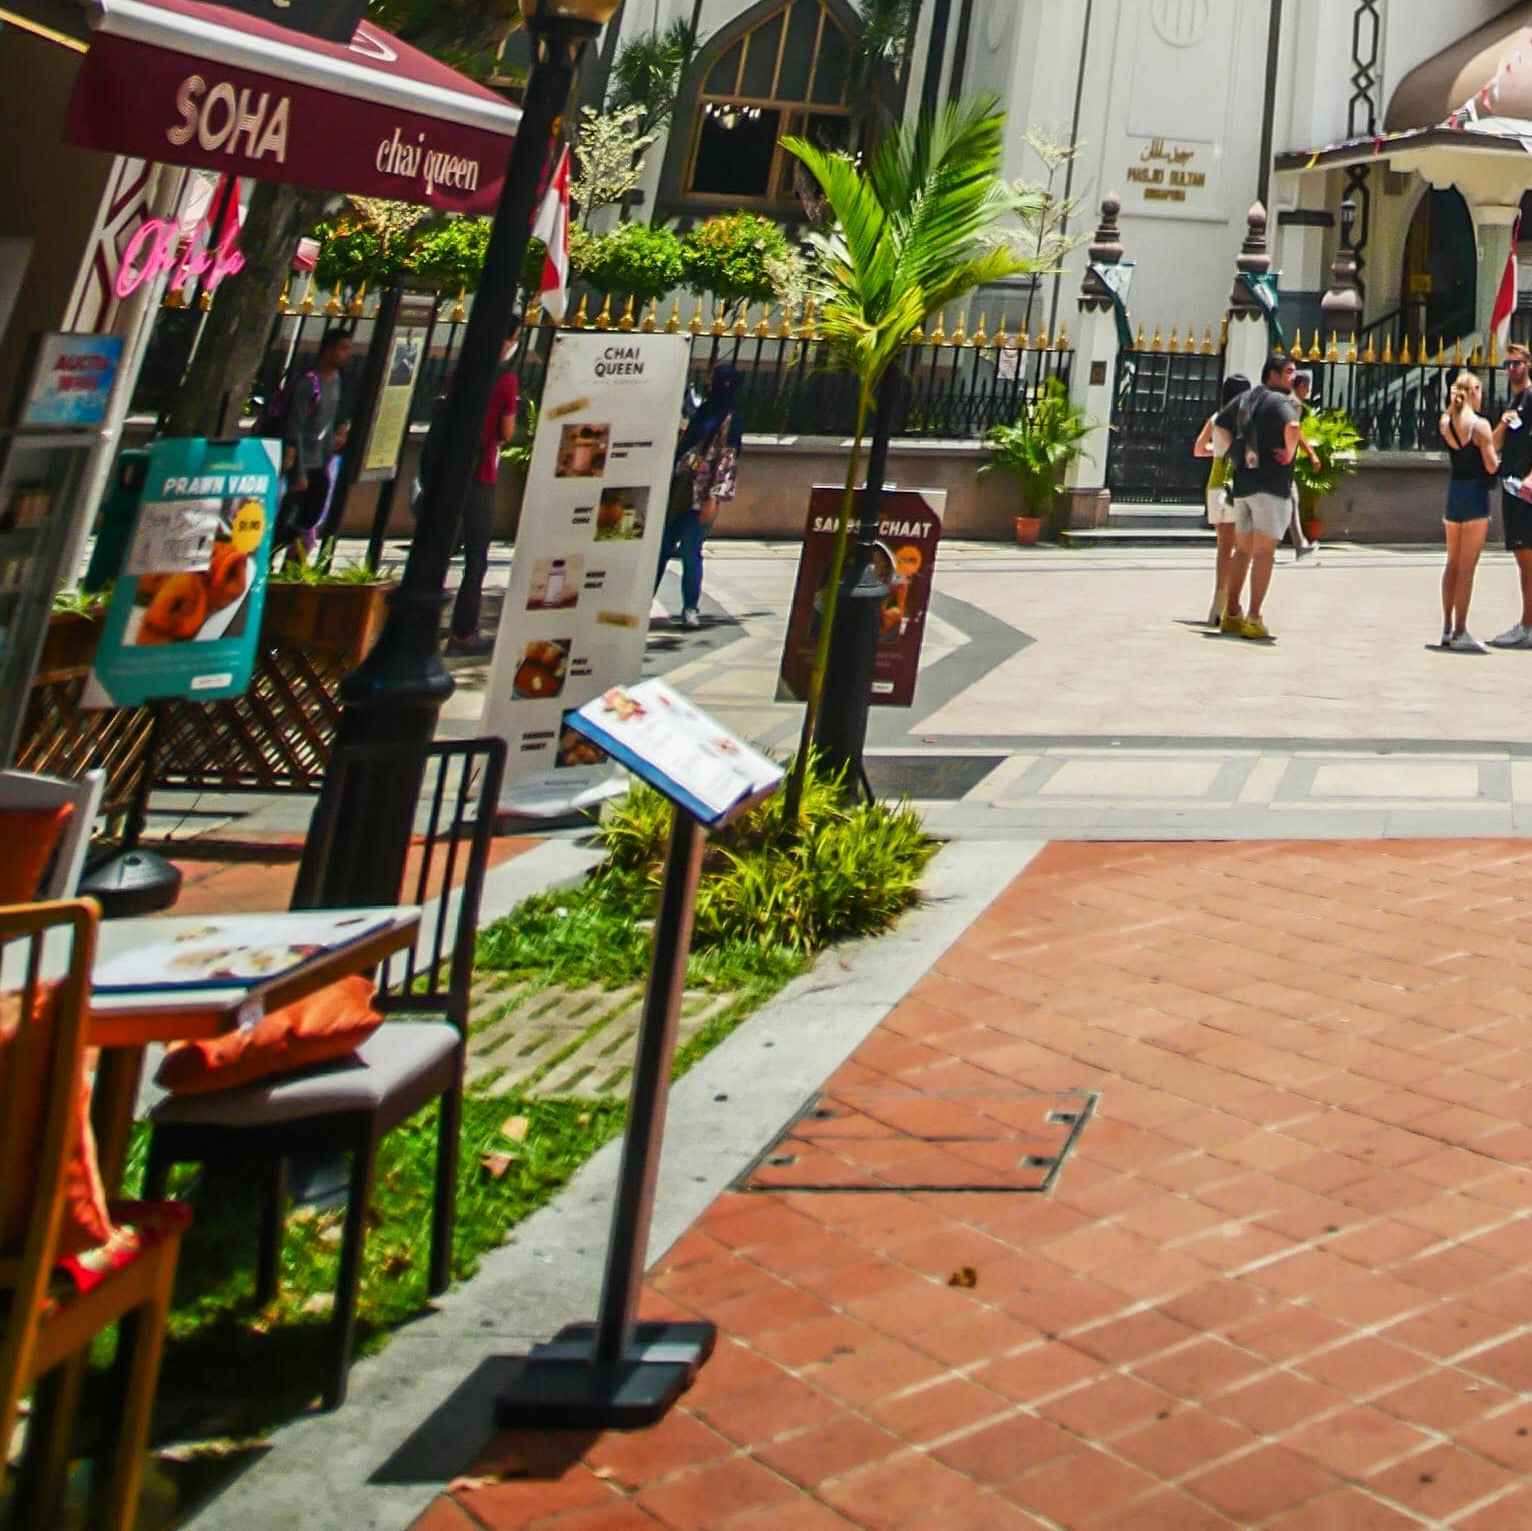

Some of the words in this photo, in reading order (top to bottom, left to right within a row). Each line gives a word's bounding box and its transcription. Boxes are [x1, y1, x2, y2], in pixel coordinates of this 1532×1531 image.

[166, 74, 291, 164] SOHA
[376, 127, 425, 179] chai
[422, 148, 480, 196] queen
[604, 347, 641, 360] CHAI
[594, 362, 645, 378] QUEEN
[161, 475, 226, 496] PRAWN
[879, 521, 932, 538] CHAAT
